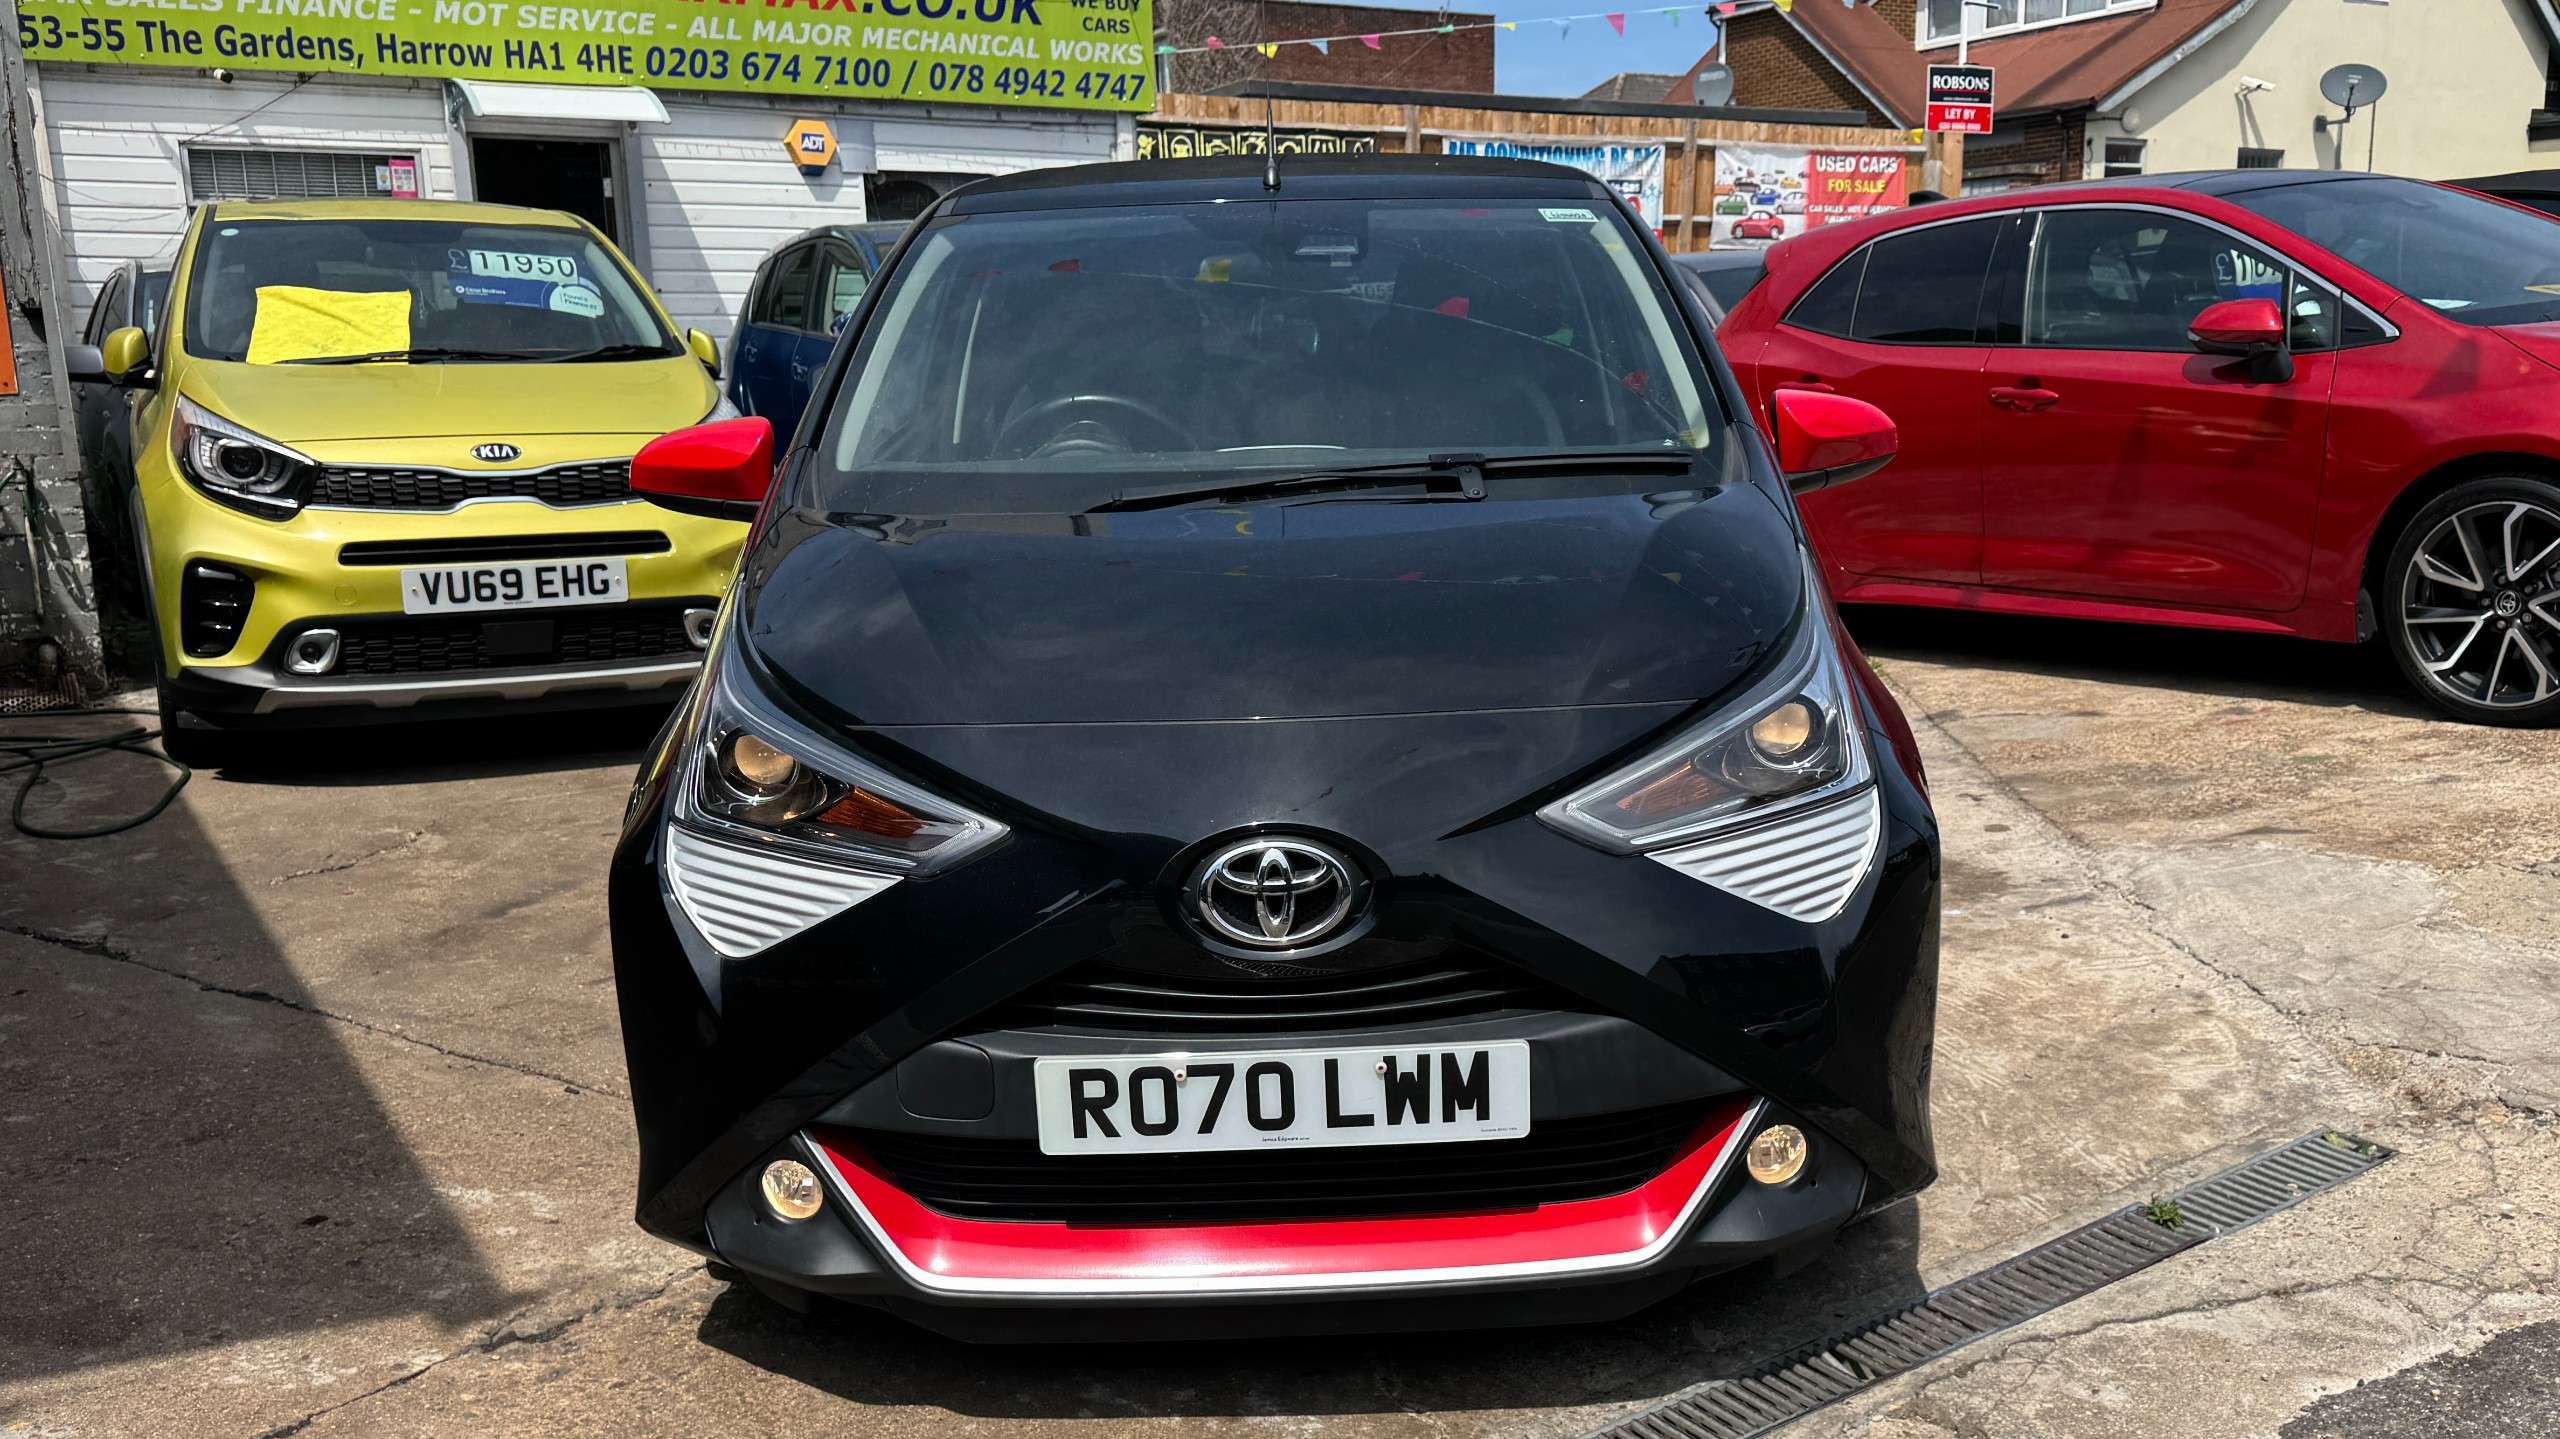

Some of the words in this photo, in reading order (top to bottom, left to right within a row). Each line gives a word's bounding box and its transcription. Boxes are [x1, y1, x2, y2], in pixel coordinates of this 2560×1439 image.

[1105, 0, 1140, 12] BUY
[236, 0, 397, 21] FINANCE
[433, 0, 508, 27] MOT
[517, 5, 656, 35] SERVICE
[687, 16, 742, 40] ALL
[752, 20, 852, 47] MAJOR
[862, 27, 1040, 60] MECHANICAL
[1050, 39, 1145, 65] WORKS
[1082, 16, 1130, 34] CARS
[20, 14, 125, 51] 53-55
[136, 20, 203, 54] The
[214, 24, 363, 69] Gardens,
[376, 33, 492, 67] Harrow
[504, 39, 565, 71] HA1
[577, 43, 634, 75] 4HE
[646, 46, 729, 80] 0203
[741, 52, 801, 83] 674
[814, 56, 891, 88] 7100
[929, 63, 985, 93] 078
[994, 67, 1066, 98] 4942
[1075, 71, 1146, 101] 4747
[1933, 75, 1990, 91] ROBSONS
[1945, 108, 1961, 120] LET
[1963, 109, 1977, 120] BY
[801, 136, 824, 151] ADT
[1816, 155, 1856, 173] USED
[1860, 156, 1898, 174] CARS
[1828, 179, 1852, 193] FOR
[1855, 179, 1886, 193] SALE
[480, 445, 513, 458] KIA
[420, 568, 523, 606] VU69
[536, 563, 610, 600] EHG
[1068, 1061, 1296, 1139] RO70
[1324, 1051, 1490, 1129] LWM
